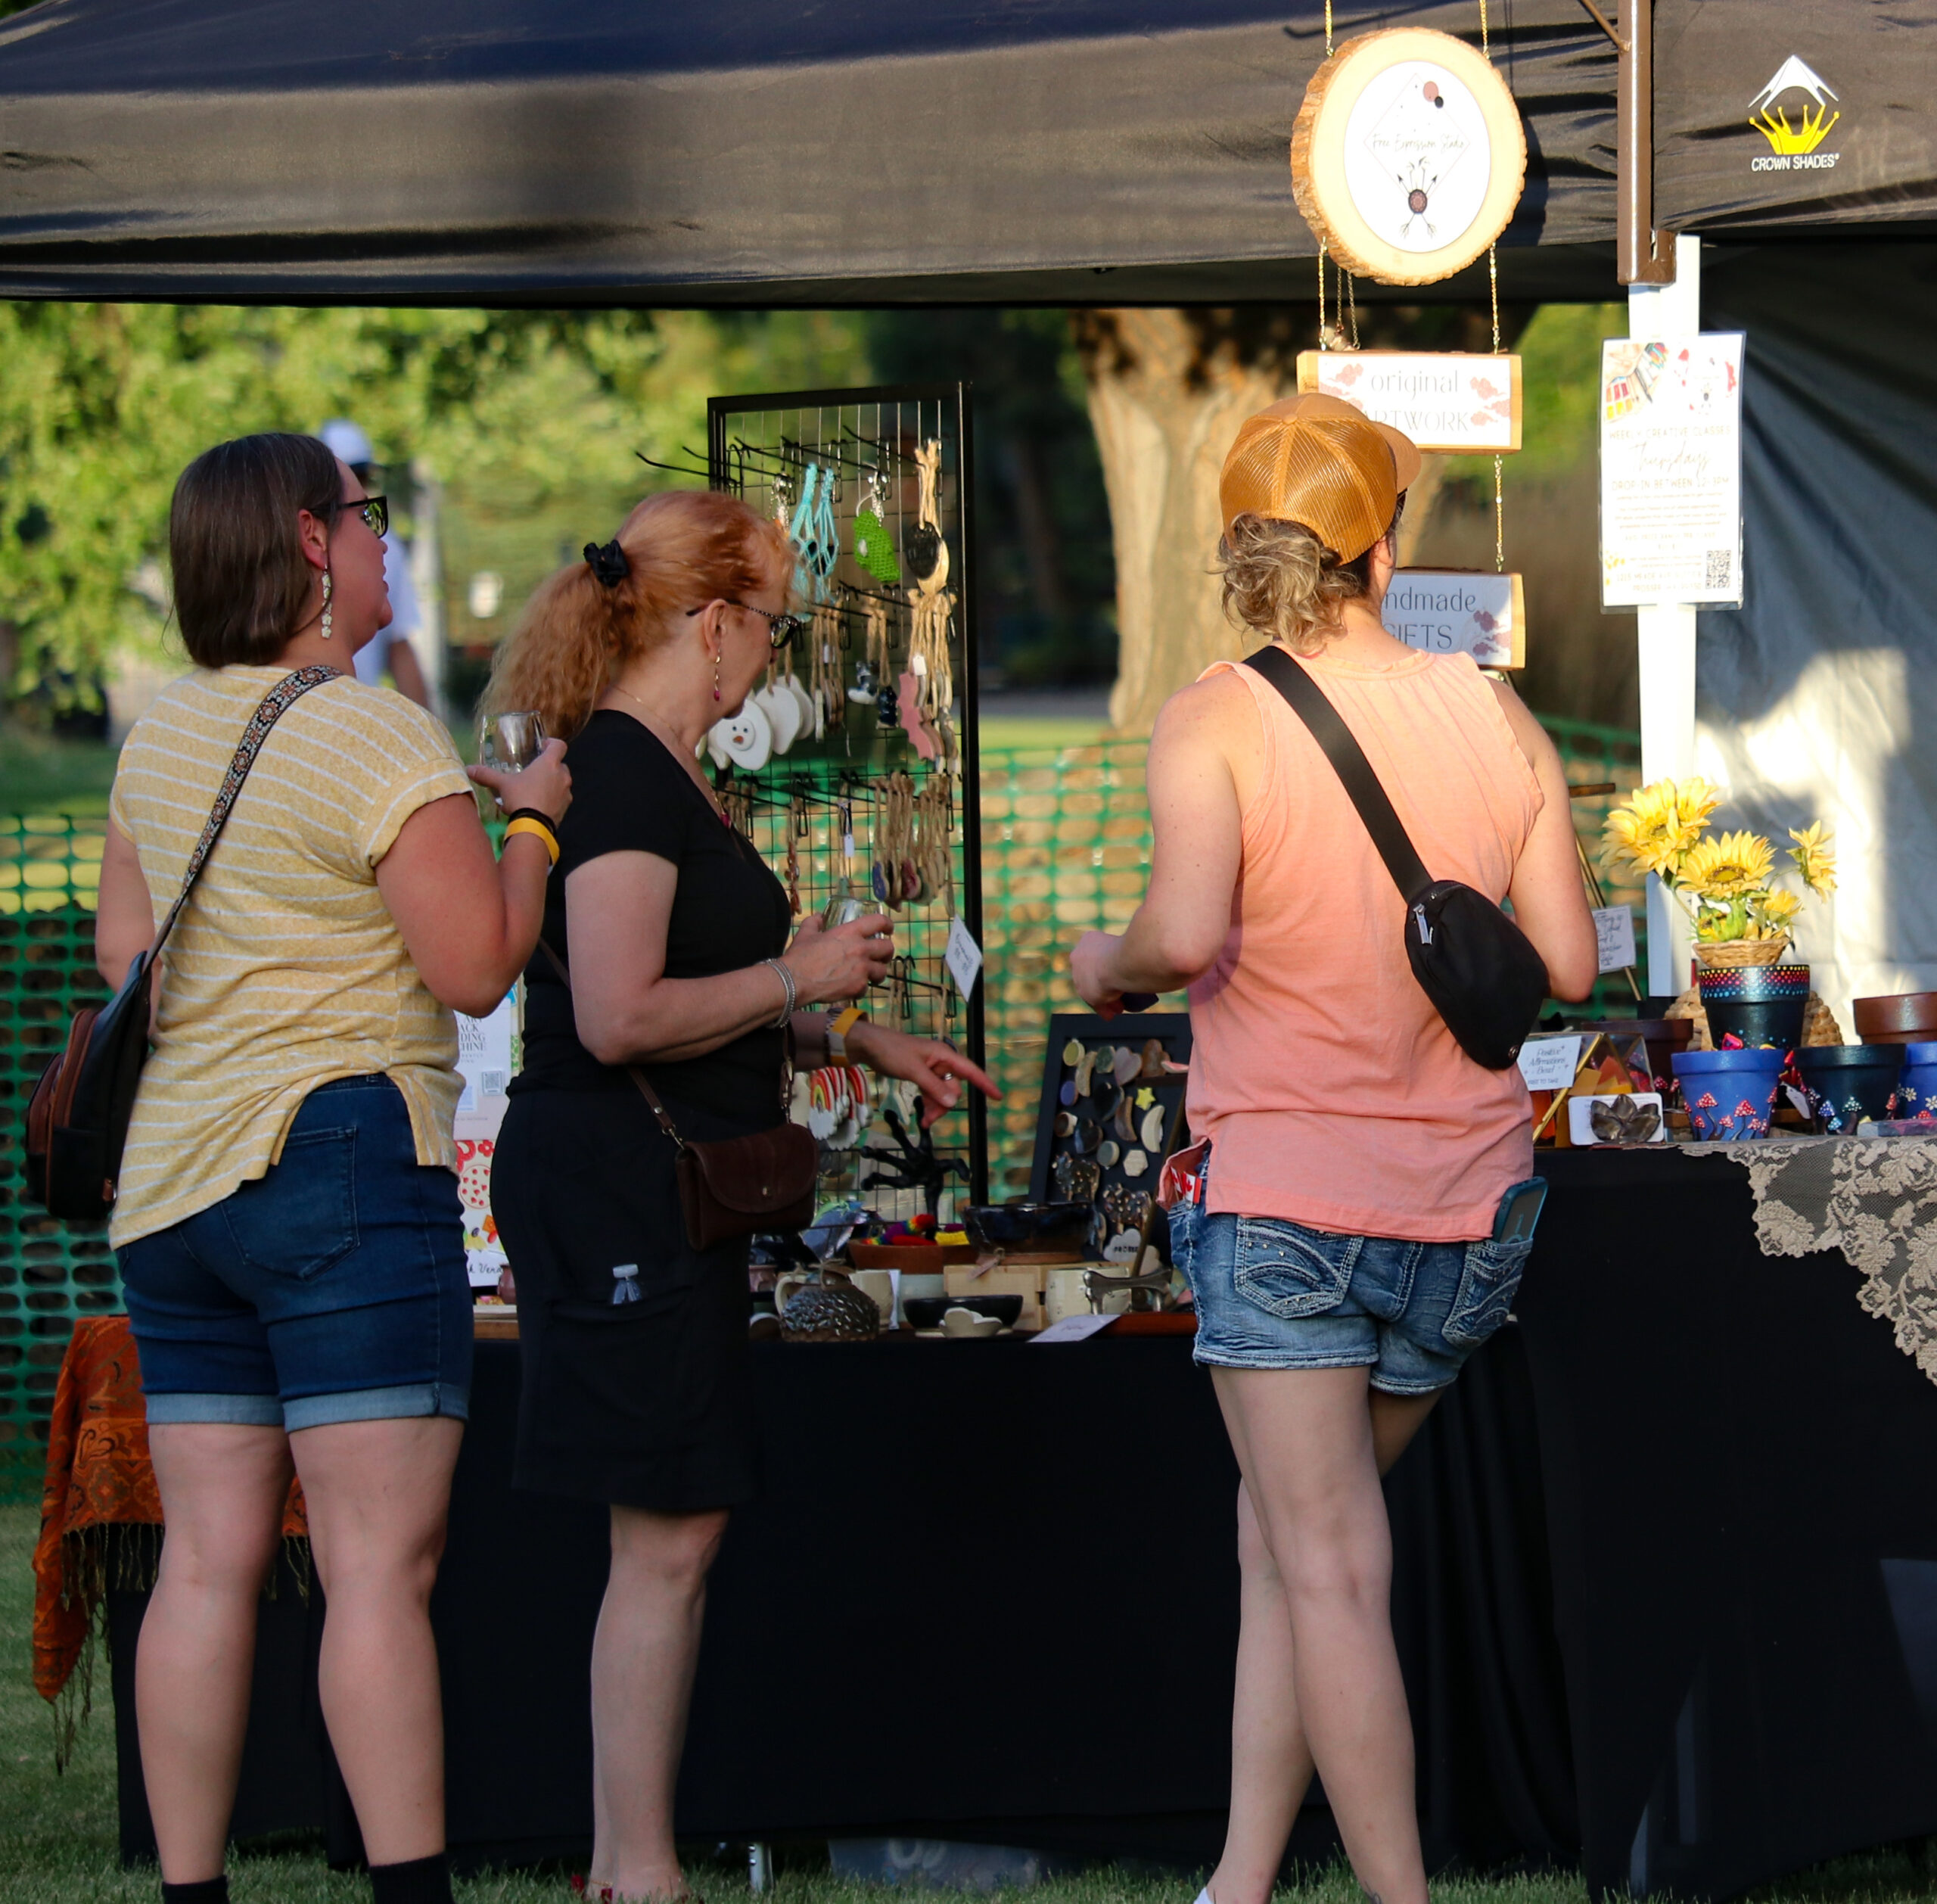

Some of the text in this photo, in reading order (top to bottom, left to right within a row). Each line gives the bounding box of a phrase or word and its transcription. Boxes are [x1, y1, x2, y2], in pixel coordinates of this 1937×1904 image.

[1372, 133, 1390, 151] Free
[1751, 156, 1791, 172] CROWN
[1370, 369, 1459, 400] original
[1693, 425, 1731, 437] CLASSES
[1385, 586, 1476, 612] ndmade
[461, 1033, 486, 1042] DING
